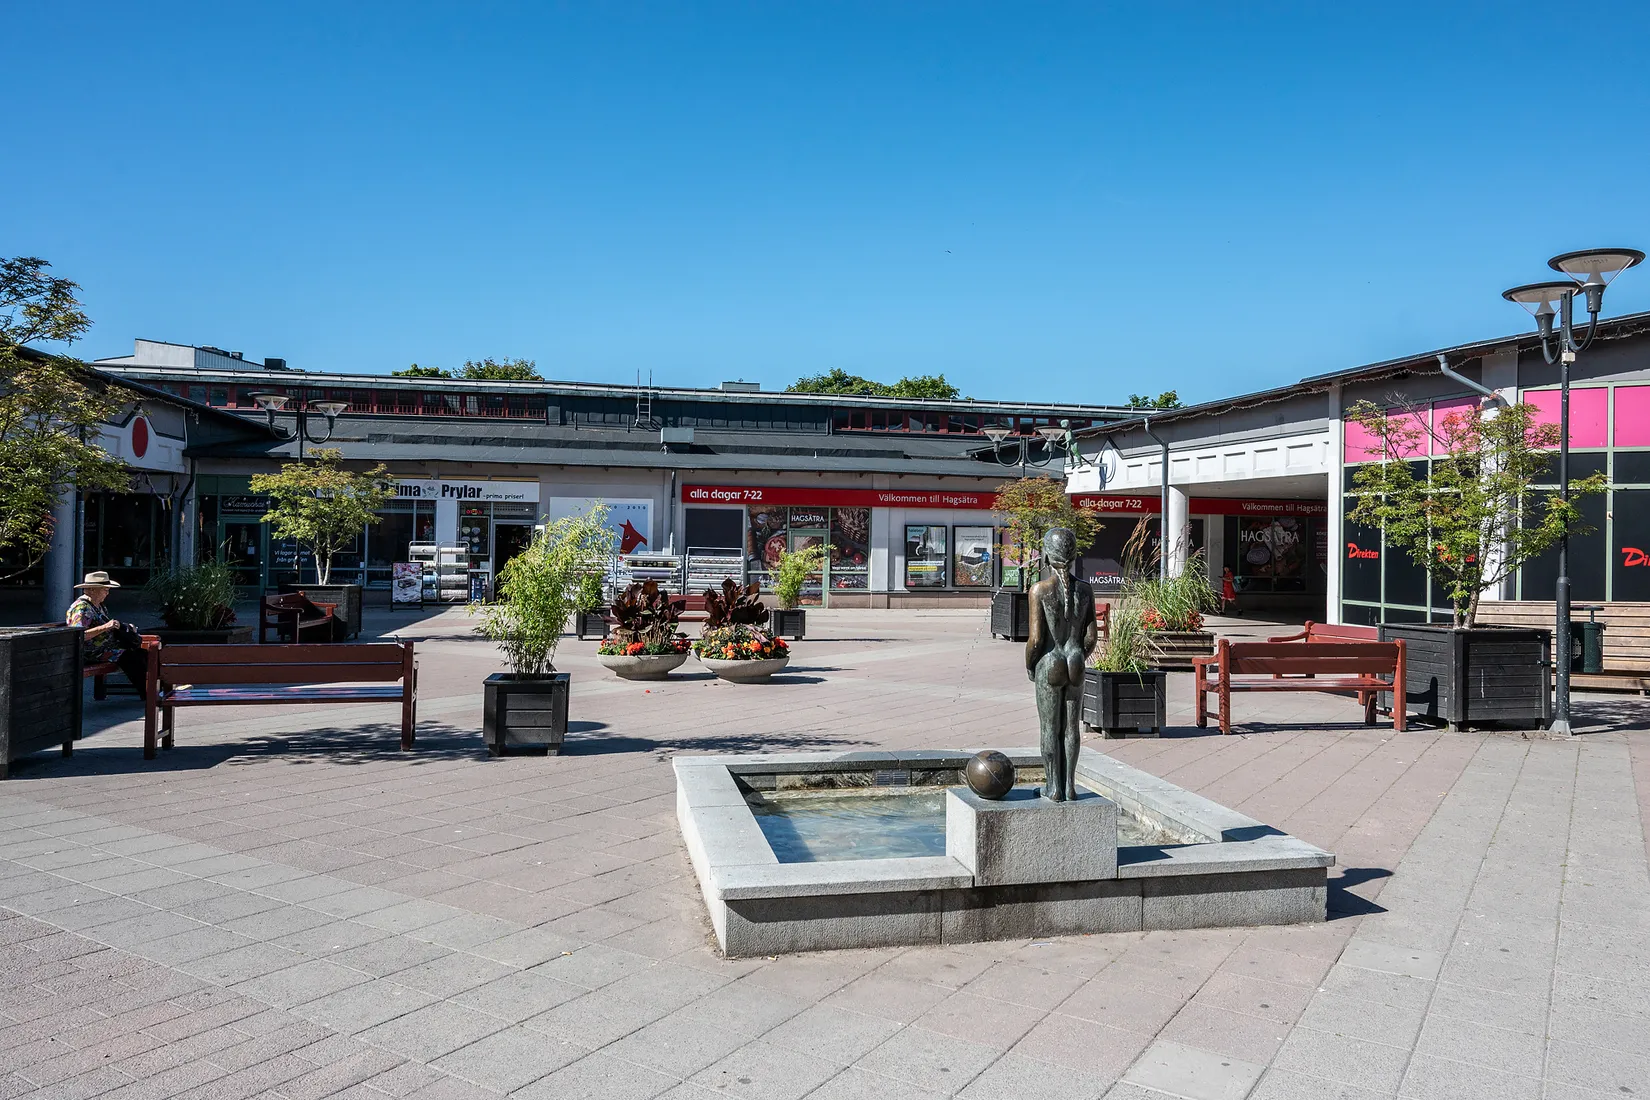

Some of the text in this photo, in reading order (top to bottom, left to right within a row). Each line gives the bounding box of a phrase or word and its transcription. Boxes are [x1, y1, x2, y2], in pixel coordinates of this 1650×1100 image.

[441, 484, 483, 499] Prylar
[690, 488, 763, 501] alla dagar 7-22
[878, 493, 978, 506] Välkommen till Hagsätra
[1079, 498, 1142, 510] alla dagar 7-22
[1241, 502, 1327, 514] Välkommen till Hagsätra
[791, 513, 825, 522] HAGSÄTRA
[1347, 542, 1379, 559] Direkten
[1089, 575, 1126, 584] HAGSÄTRA
